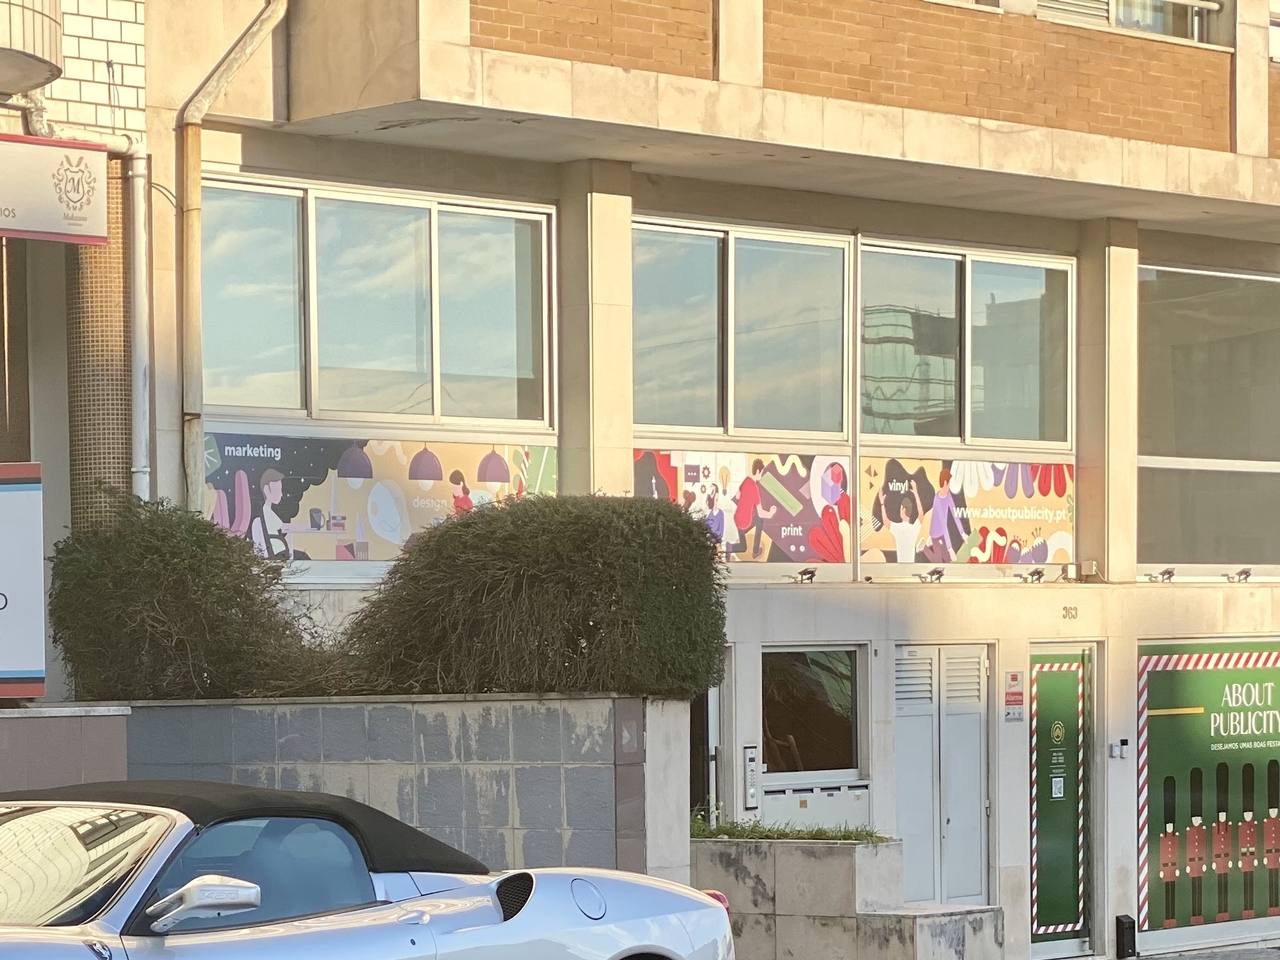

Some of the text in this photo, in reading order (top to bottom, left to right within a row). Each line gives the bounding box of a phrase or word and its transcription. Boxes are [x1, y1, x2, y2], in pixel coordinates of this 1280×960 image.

[224, 444, 282, 461] marketing
[888, 479, 909, 493] vinyl
[413, 496, 448, 511] design
[953, 505, 1068, 524] www.aboutpublicity.pt
[781, 523, 803, 538] print
[1062, 606, 1078, 620] 363
[1221, 682, 1275, 707] ABOUT
[1210, 742, 1239, 751] DESEJAMOS
[1240, 741, 1253, 749] UMAS
